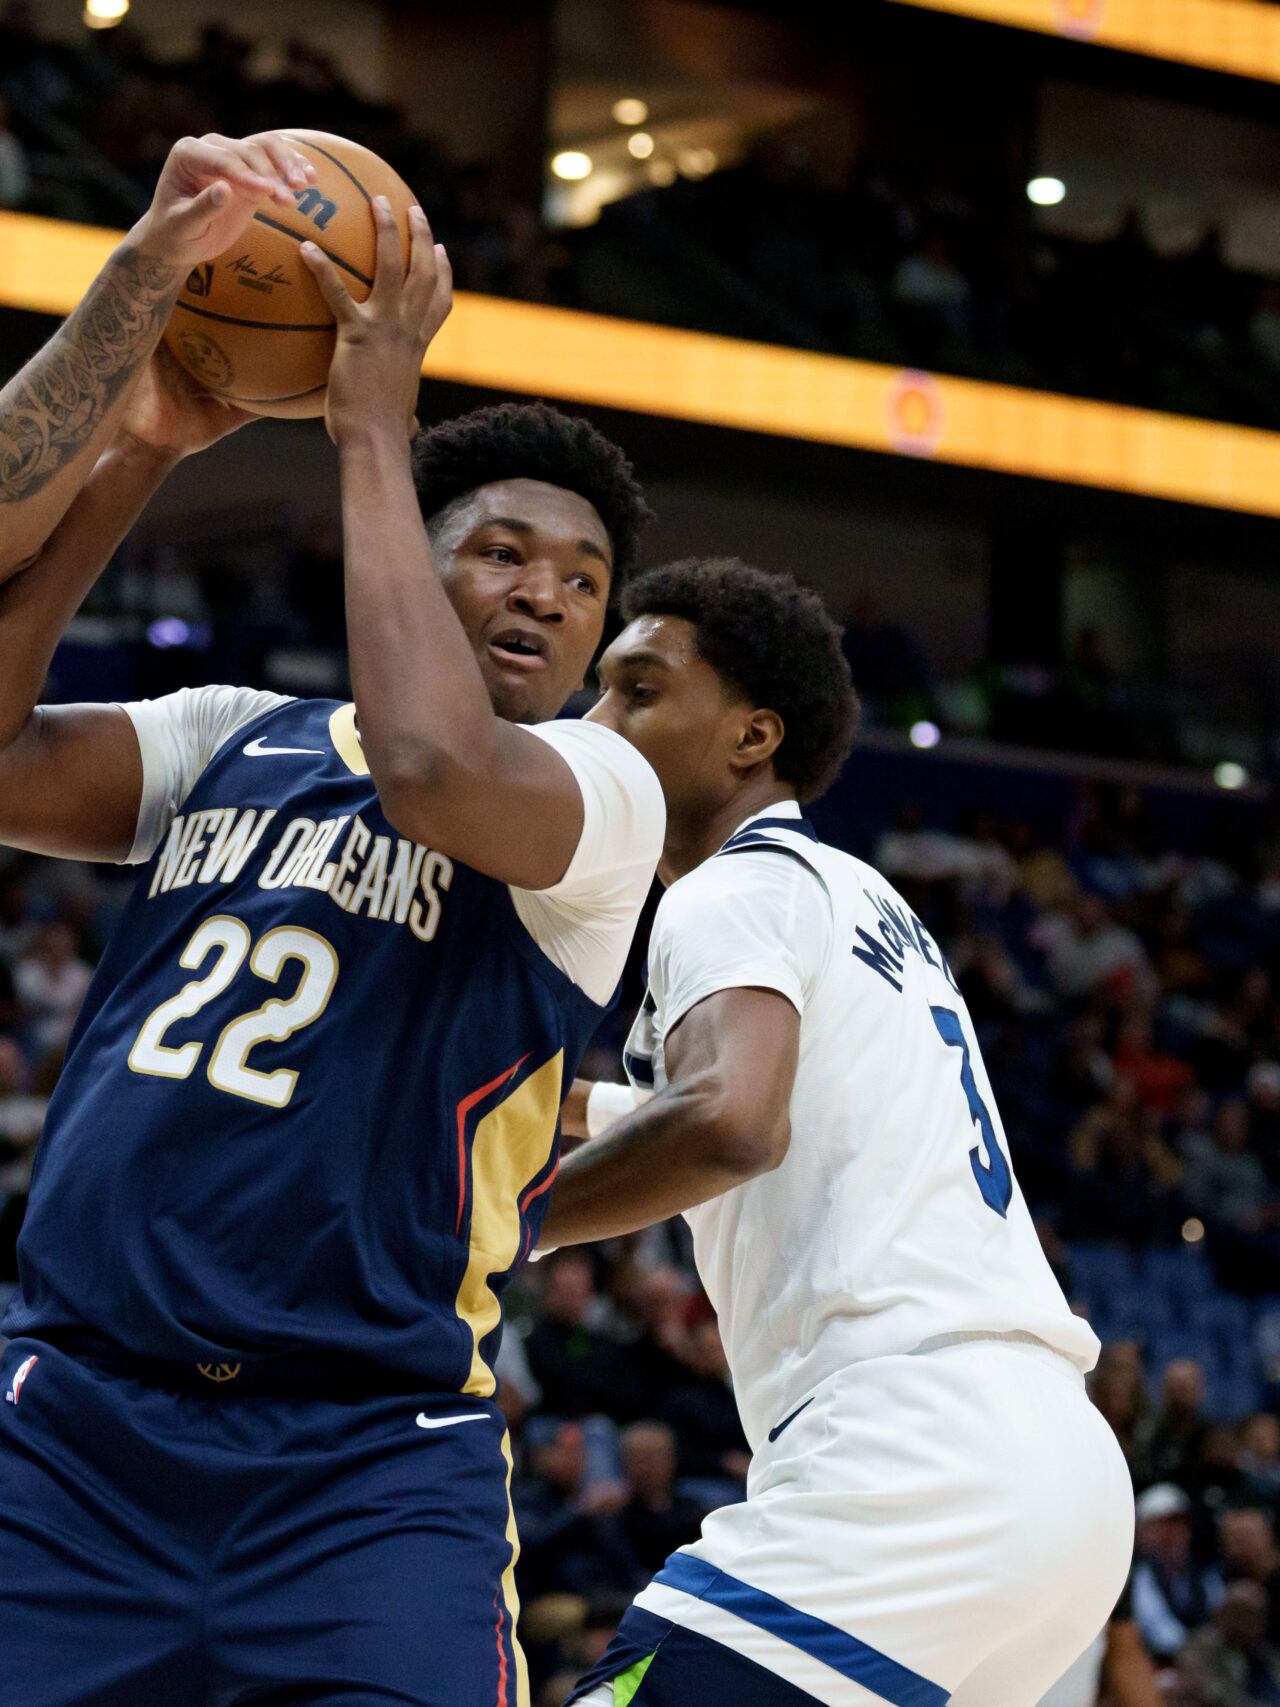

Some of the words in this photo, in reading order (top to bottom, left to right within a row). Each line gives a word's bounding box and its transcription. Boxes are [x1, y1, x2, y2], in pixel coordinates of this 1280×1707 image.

[148, 808, 277, 899] NEW
[258, 815, 455, 942] ORLEANS
[127, 915, 339, 1108] 22
[929, 1004, 1013, 1220] 3
